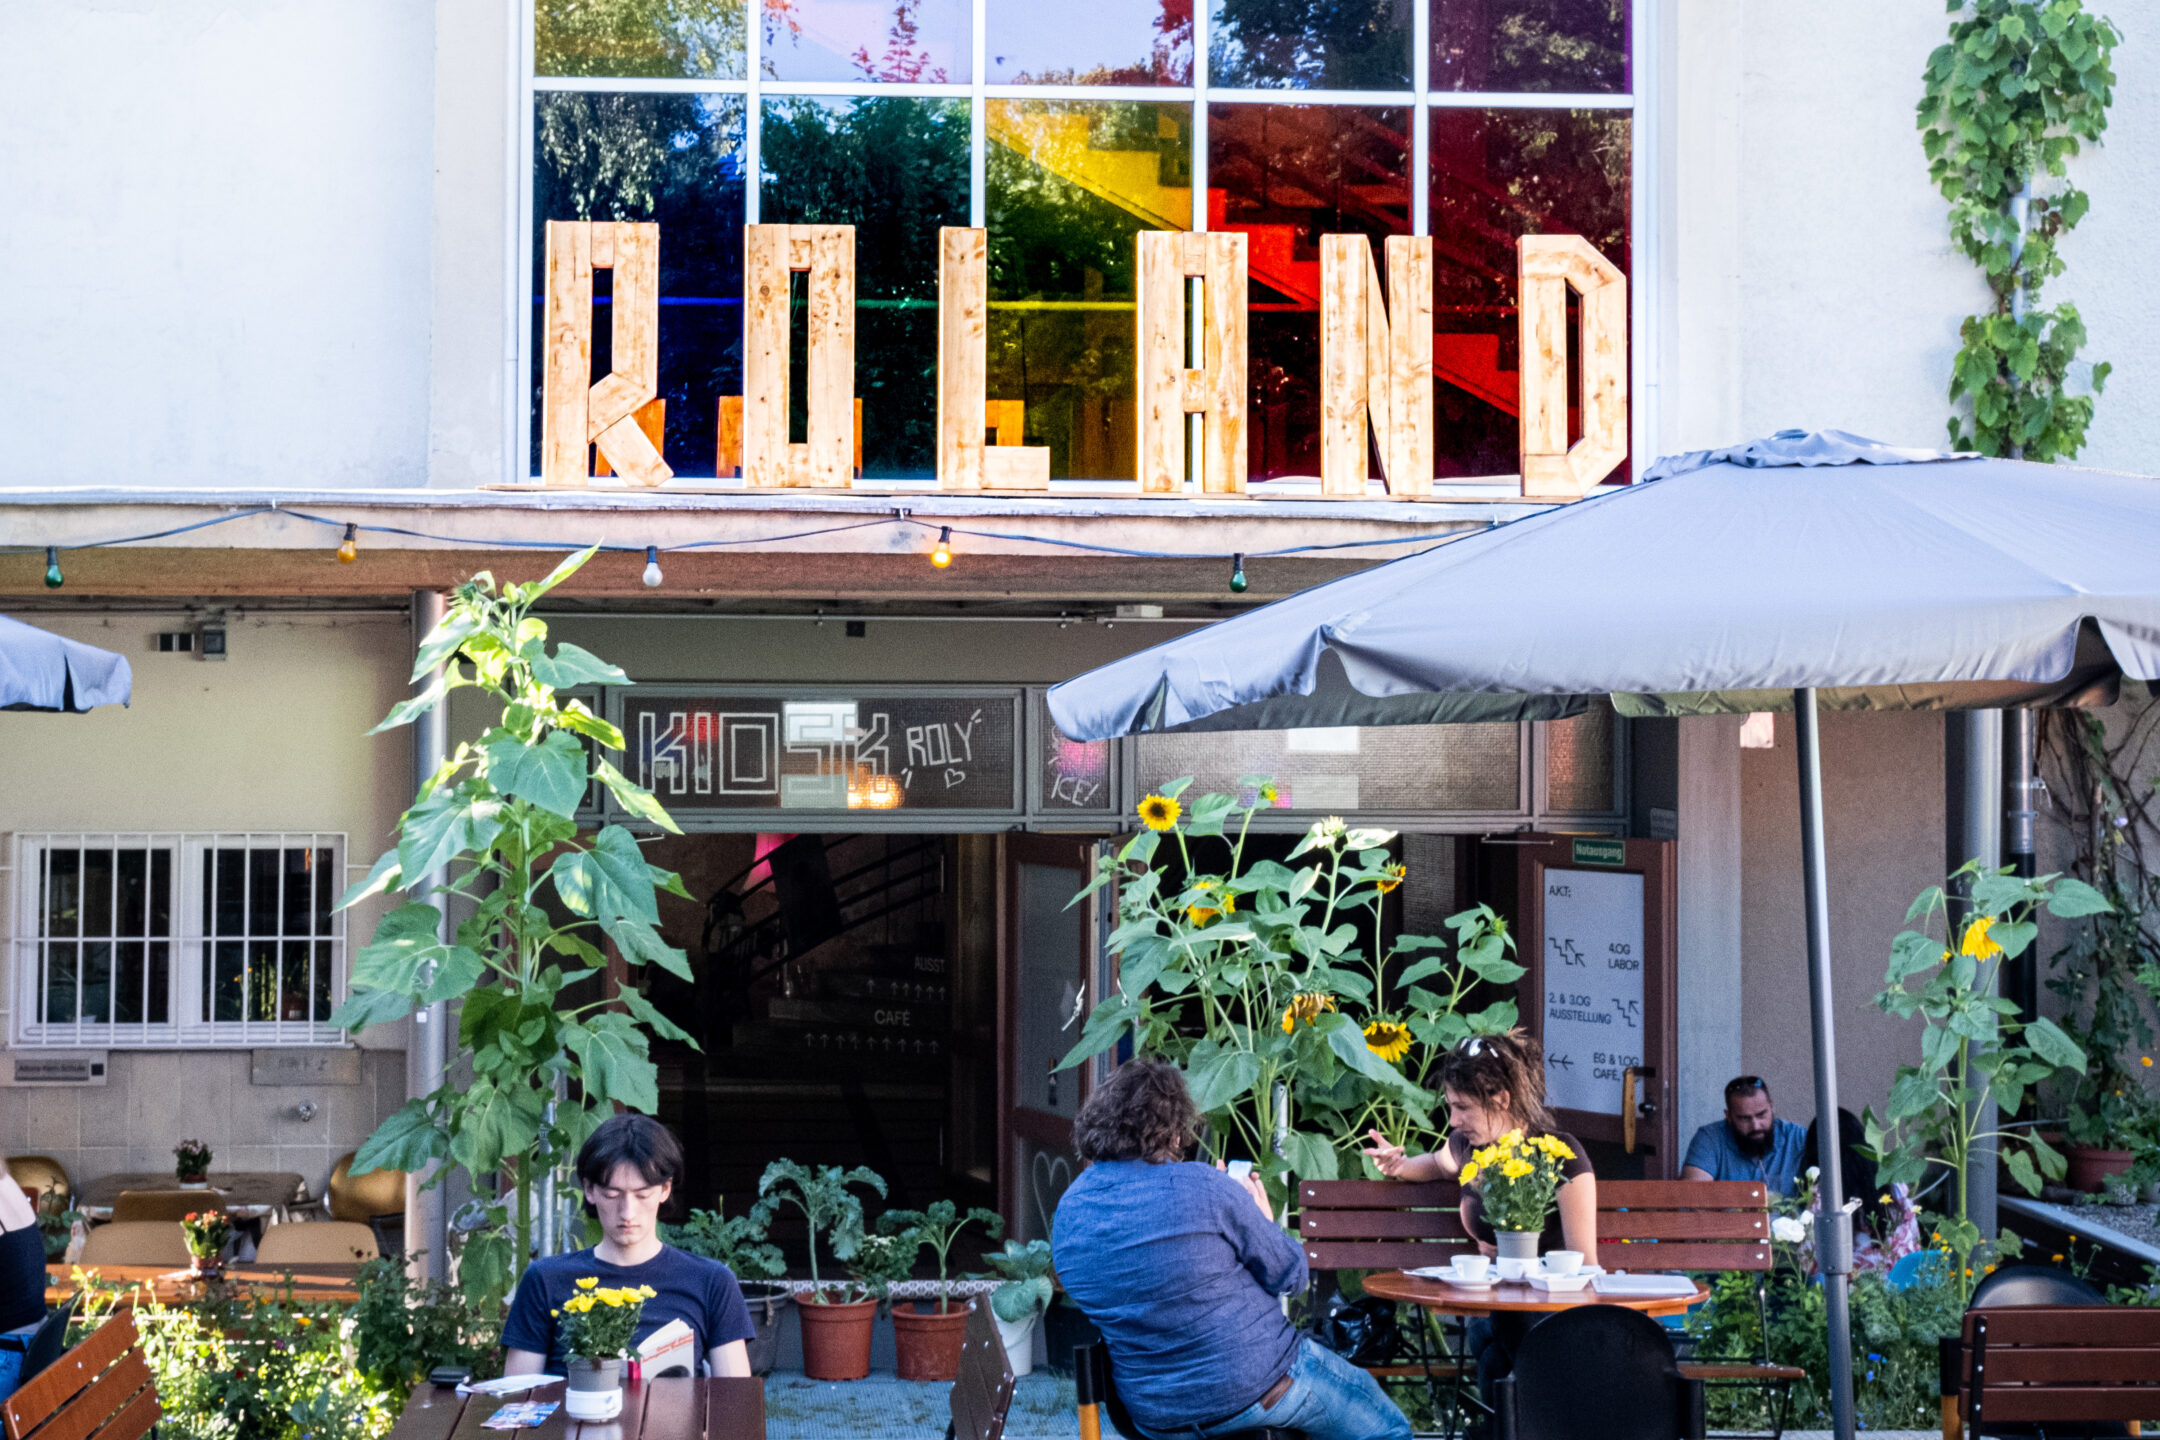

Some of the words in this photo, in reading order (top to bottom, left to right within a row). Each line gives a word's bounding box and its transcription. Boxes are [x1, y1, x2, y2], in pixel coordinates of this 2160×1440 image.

[542, 219, 1628, 497] ROLAND
[639, 712, 889, 794] KIOSK
[1050, 773, 1099, 806] ICE!
[1575, 843, 1622, 860] Notausgang
[1607, 958, 1640, 970] LABOR
[1559, 993, 1566, 1005] &
[1548, 1007, 1612, 1025] AUSSTELLUNG
[1593, 1052, 1606, 1064] EG
[1609, 1054, 1616, 1065] &
